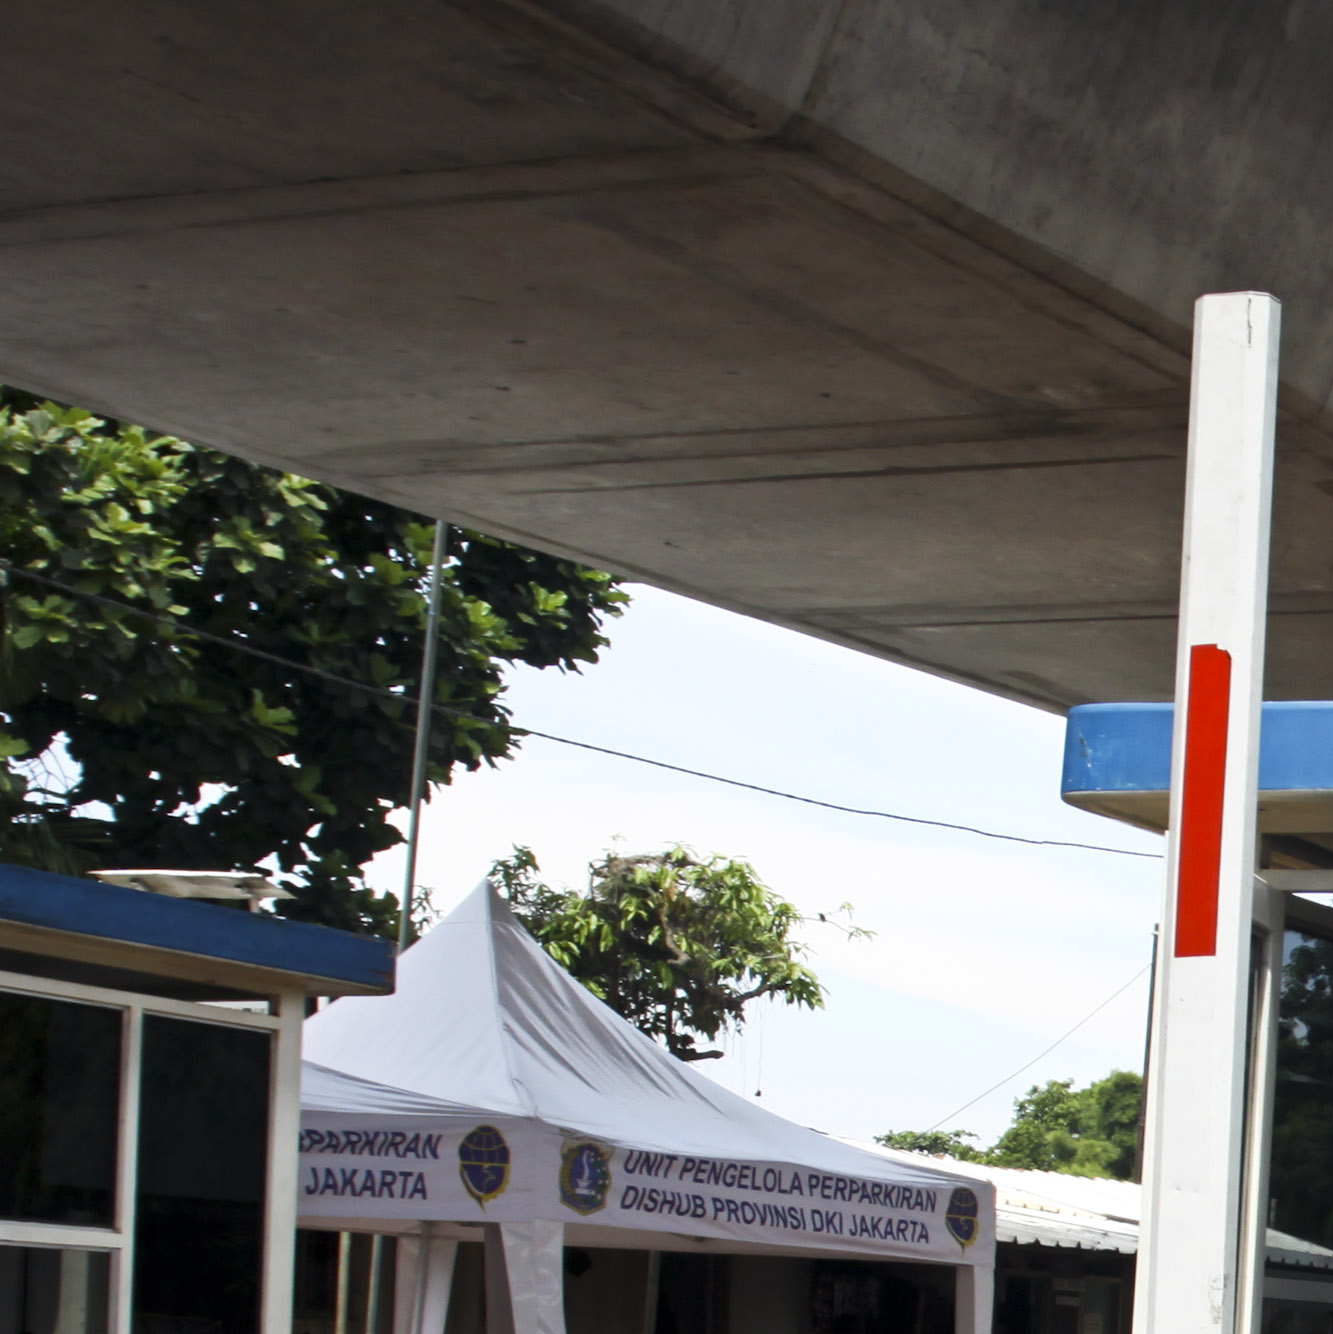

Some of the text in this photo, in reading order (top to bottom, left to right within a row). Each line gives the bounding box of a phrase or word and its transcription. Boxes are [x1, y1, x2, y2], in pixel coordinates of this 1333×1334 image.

[304, 1167, 428, 1200] JAKARTA
[623, 1150, 937, 1213] UNIT PENGELOLA PERPARKIRAN
[620, 1185, 930, 1245] DISHUB PROVINSI DKI JAKARTA
